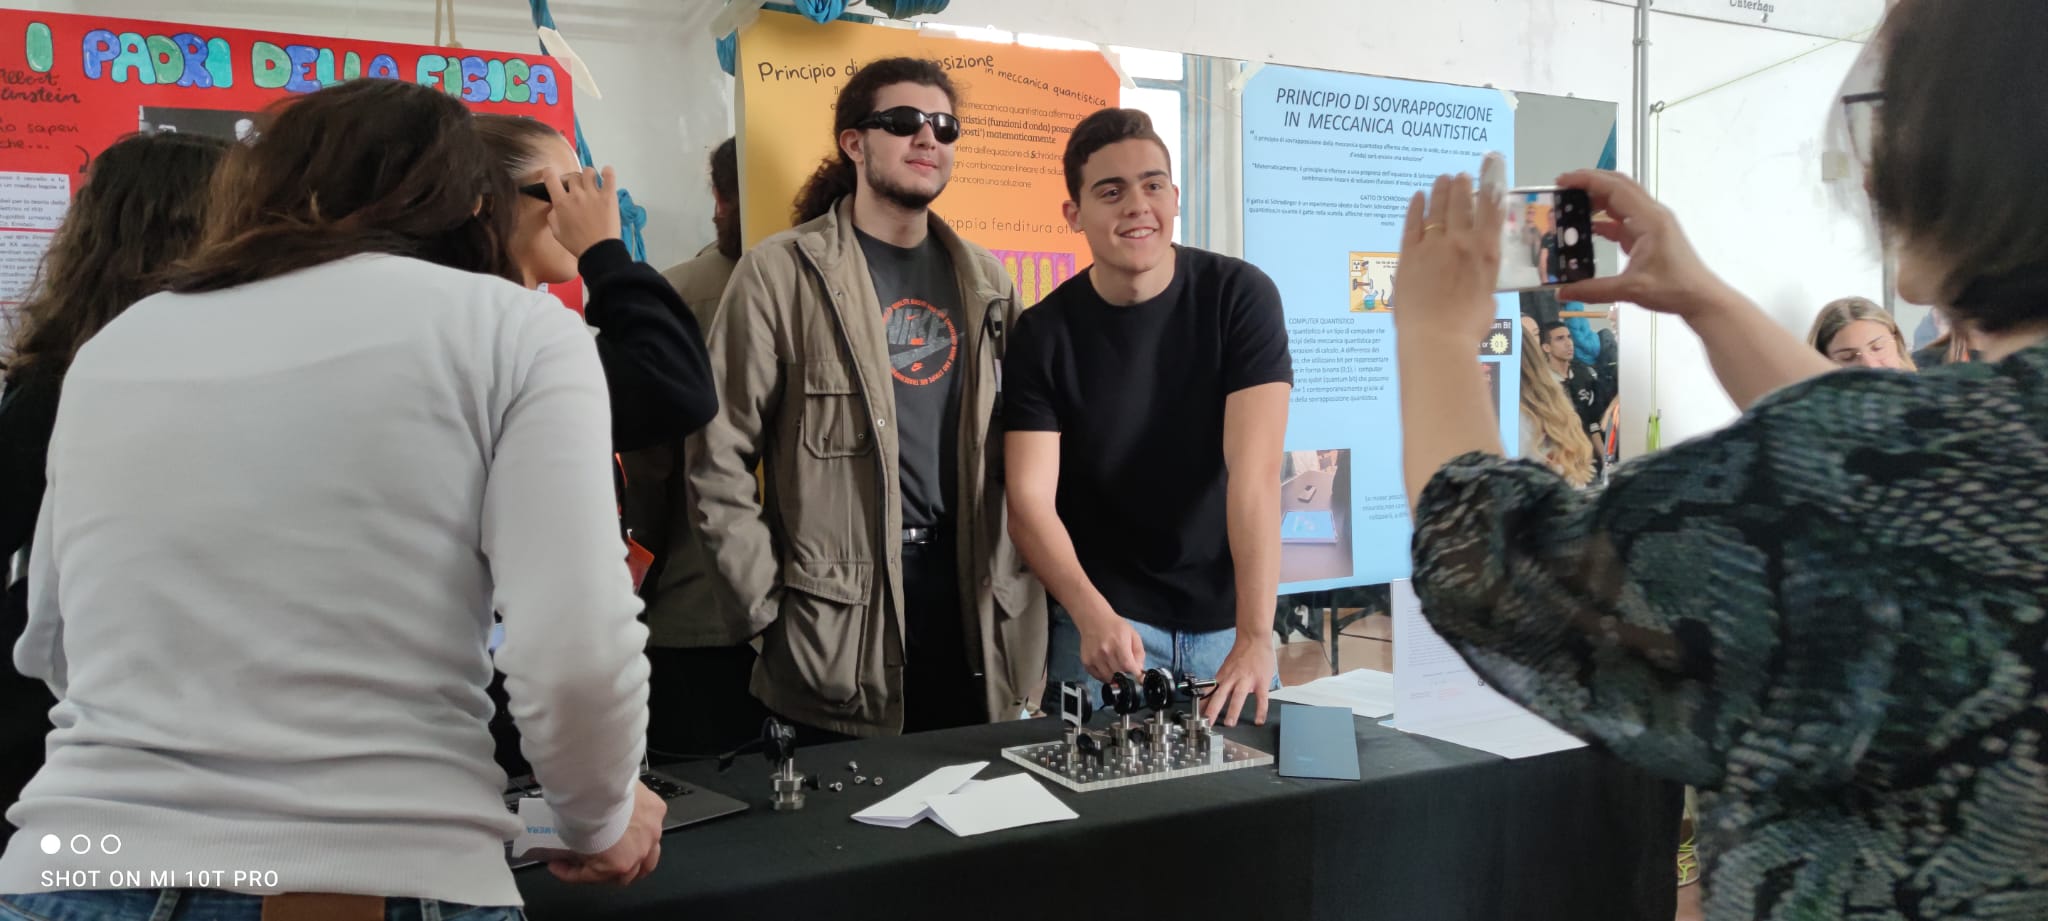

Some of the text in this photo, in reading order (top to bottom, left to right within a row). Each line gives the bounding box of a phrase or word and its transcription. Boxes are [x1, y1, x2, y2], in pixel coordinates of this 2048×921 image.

[26, 21, 559, 106] I PADRI DELLA FISICA
[758, 55, 994, 84] Principio di osizione
[985, 67, 1106, 107] in meccanica quantistica
[1276, 88, 1493, 122] PRINCIPIO DI SOVRAPPOSIZIONE
[960, 115, 988, 126] ntistici
[1051, 125, 1073, 135] posso
[986, 131, 1056, 144] matematicamente
[1284, 111, 1488, 142] IN MECCANICA QUANTISTICA
[991, 217, 1052, 234] fenditura
